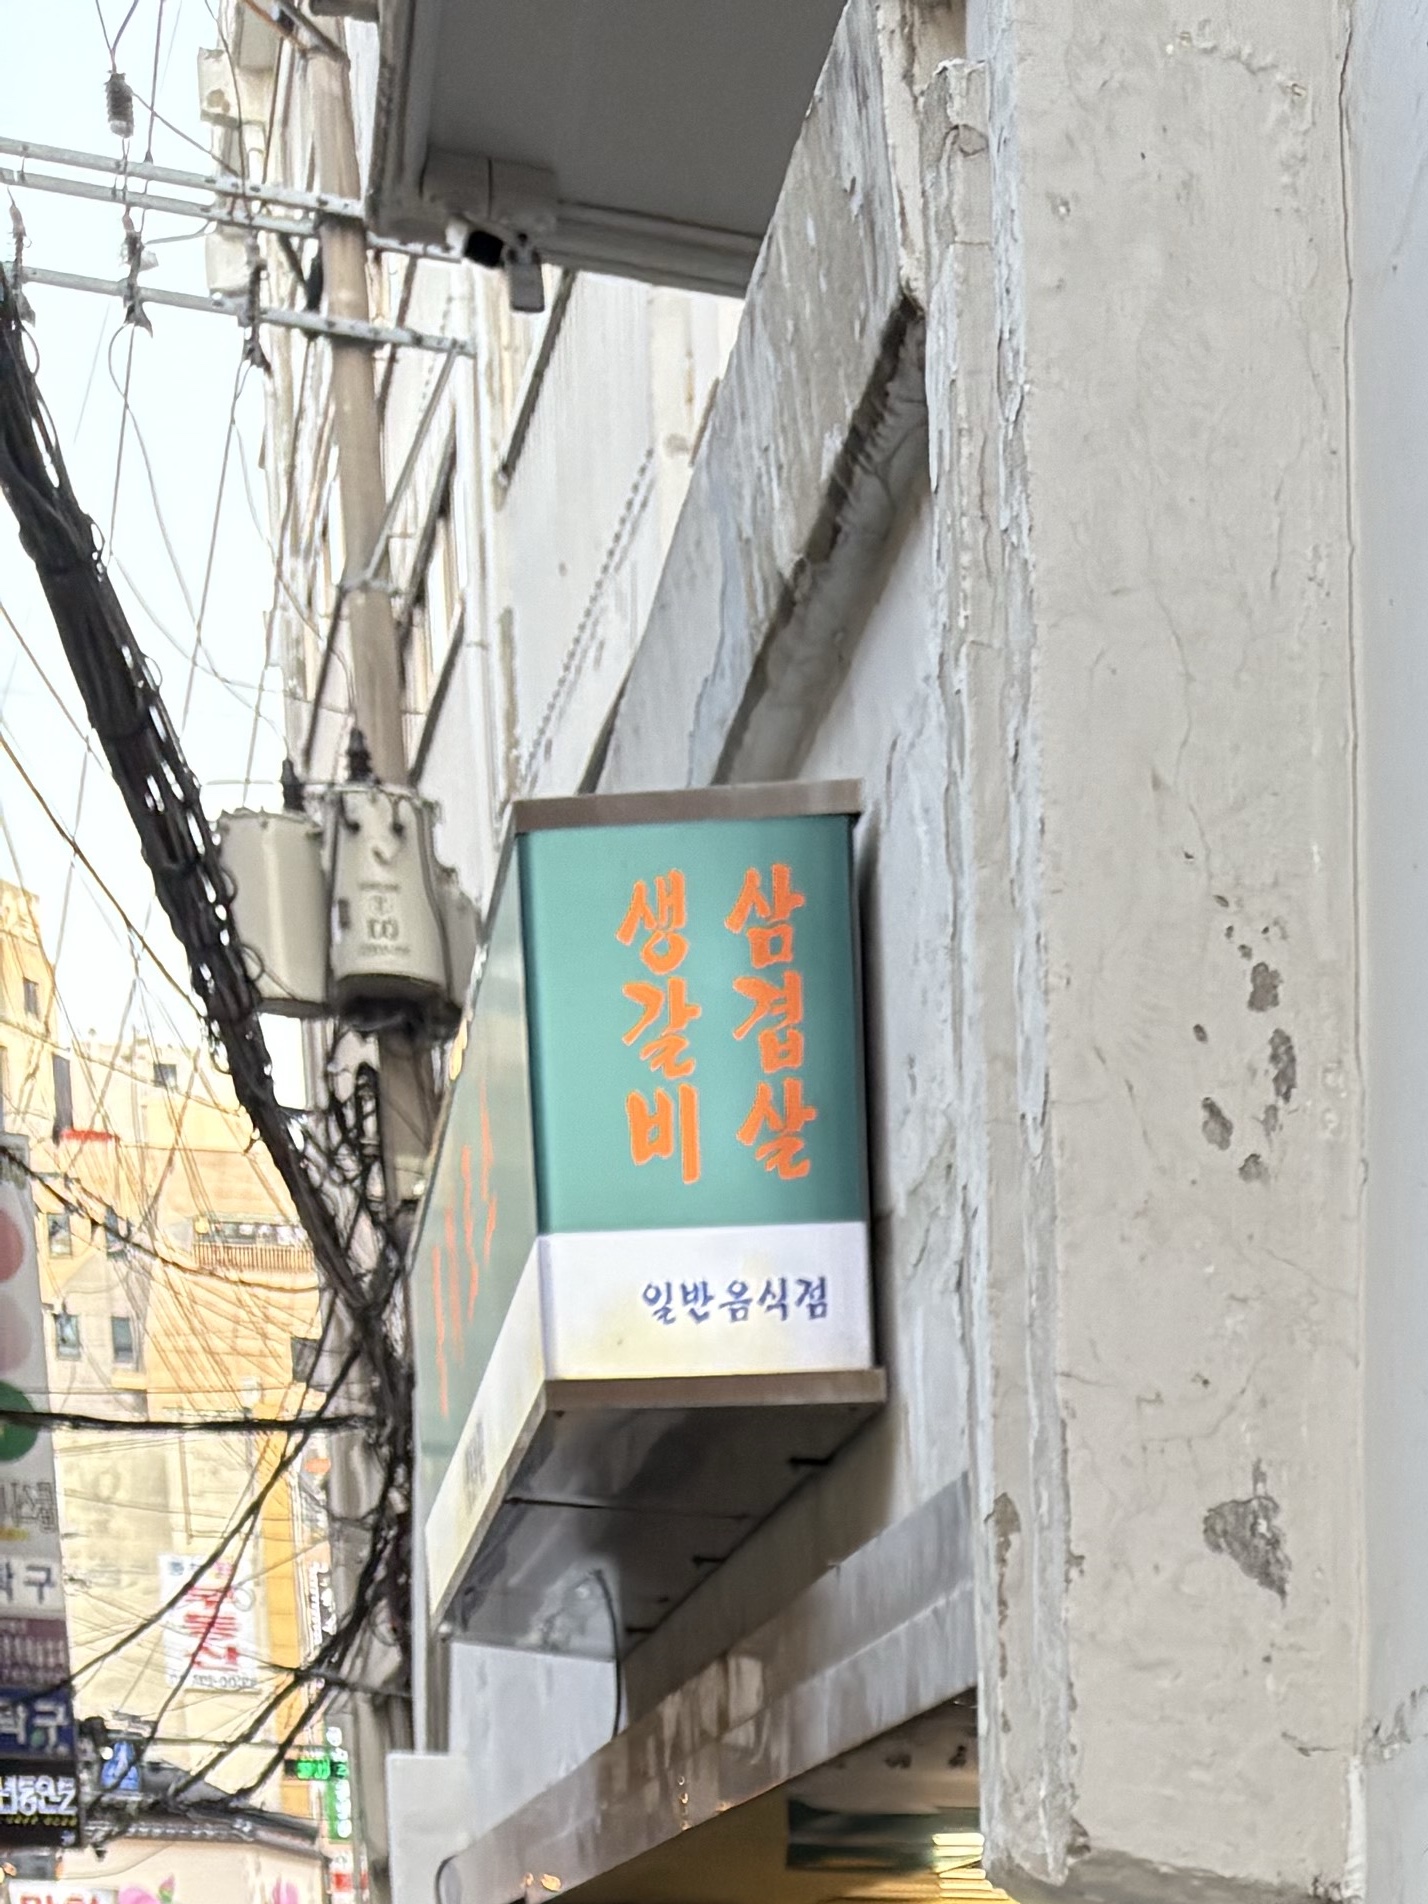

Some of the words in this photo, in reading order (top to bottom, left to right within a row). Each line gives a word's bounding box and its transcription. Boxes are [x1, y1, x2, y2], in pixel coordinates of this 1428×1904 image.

[616, 868, 702, 1184] 생갈비
[725, 863, 817, 1180] 삼겹살
[642, 1276, 828, 1325] 일반음식점
